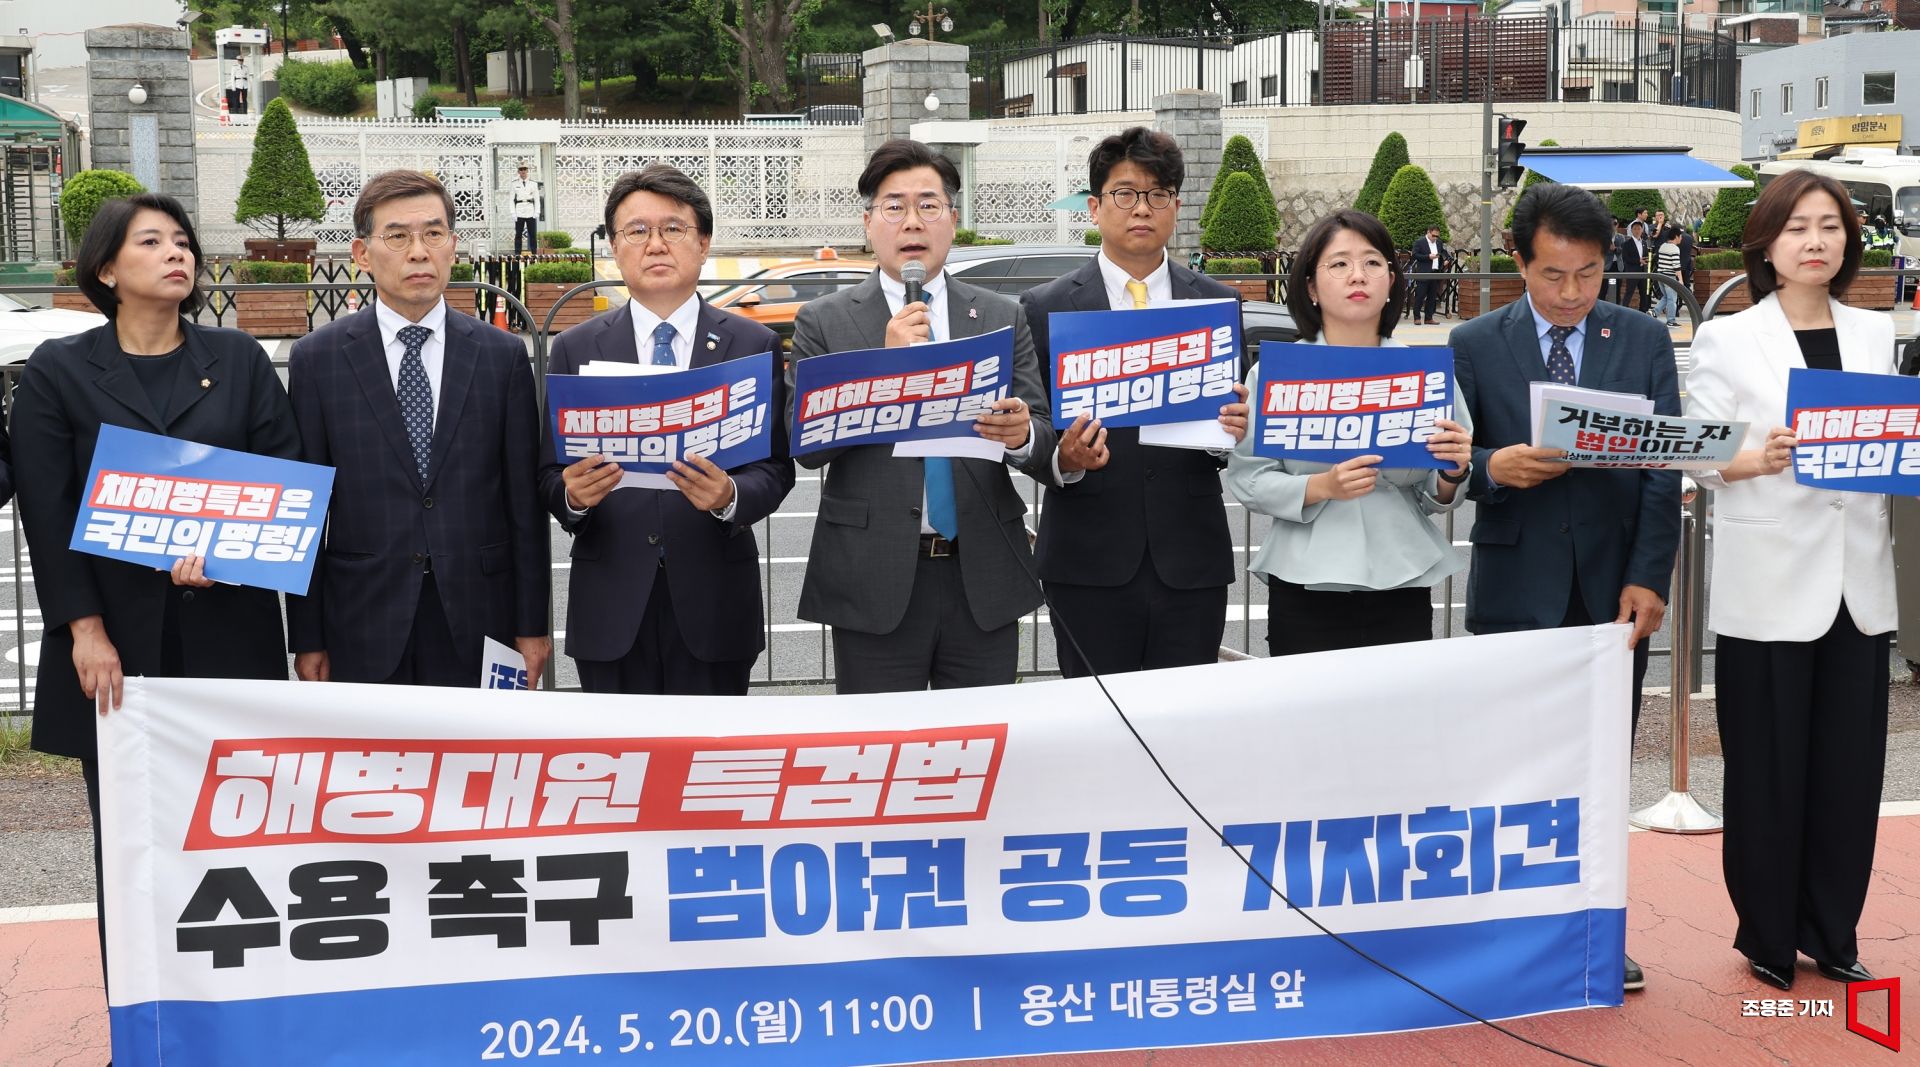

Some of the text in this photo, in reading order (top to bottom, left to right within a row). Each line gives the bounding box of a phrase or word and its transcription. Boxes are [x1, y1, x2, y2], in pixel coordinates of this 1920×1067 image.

[1061, 325, 1233, 385] 채해병특검은
[563, 377, 757, 434] 채해병특검은
[803, 355, 1000, 419] 채해병특검은
[1060, 356, 1239, 421] 국민의 명령!
[1266, 371, 1446, 412] 채해병특검은
[564, 402, 767, 463] 국민의 명령!
[800, 403, 915, 447] 국민의
[1263, 414, 1374, 450] 국민의
[1558, 406, 1732, 441] 거부하는 자
[1575, 428, 1705, 454] 범인이다
[1795, 408, 1920, 441] 채해병특
[1796, 442, 1898, 480] 국민의
[95, 473, 314, 520] 채해병특검은
[83, 511, 318, 562] 국민의 명령!
[207, 738, 996, 838] 해병대원 특검법
[176, 797, 1581, 969] 수용 촉구 범야권 공동 기자회견
[480, 1014, 602, 1061] 2024.
[617, 1013, 654, 1052] 5.
[818, 994, 934, 1037] 11:00
[1019, 982, 1096, 1027] 용산
[1110, 973, 1257, 1020] 대통령실
[1269, 969, 1306, 1009] 앞
